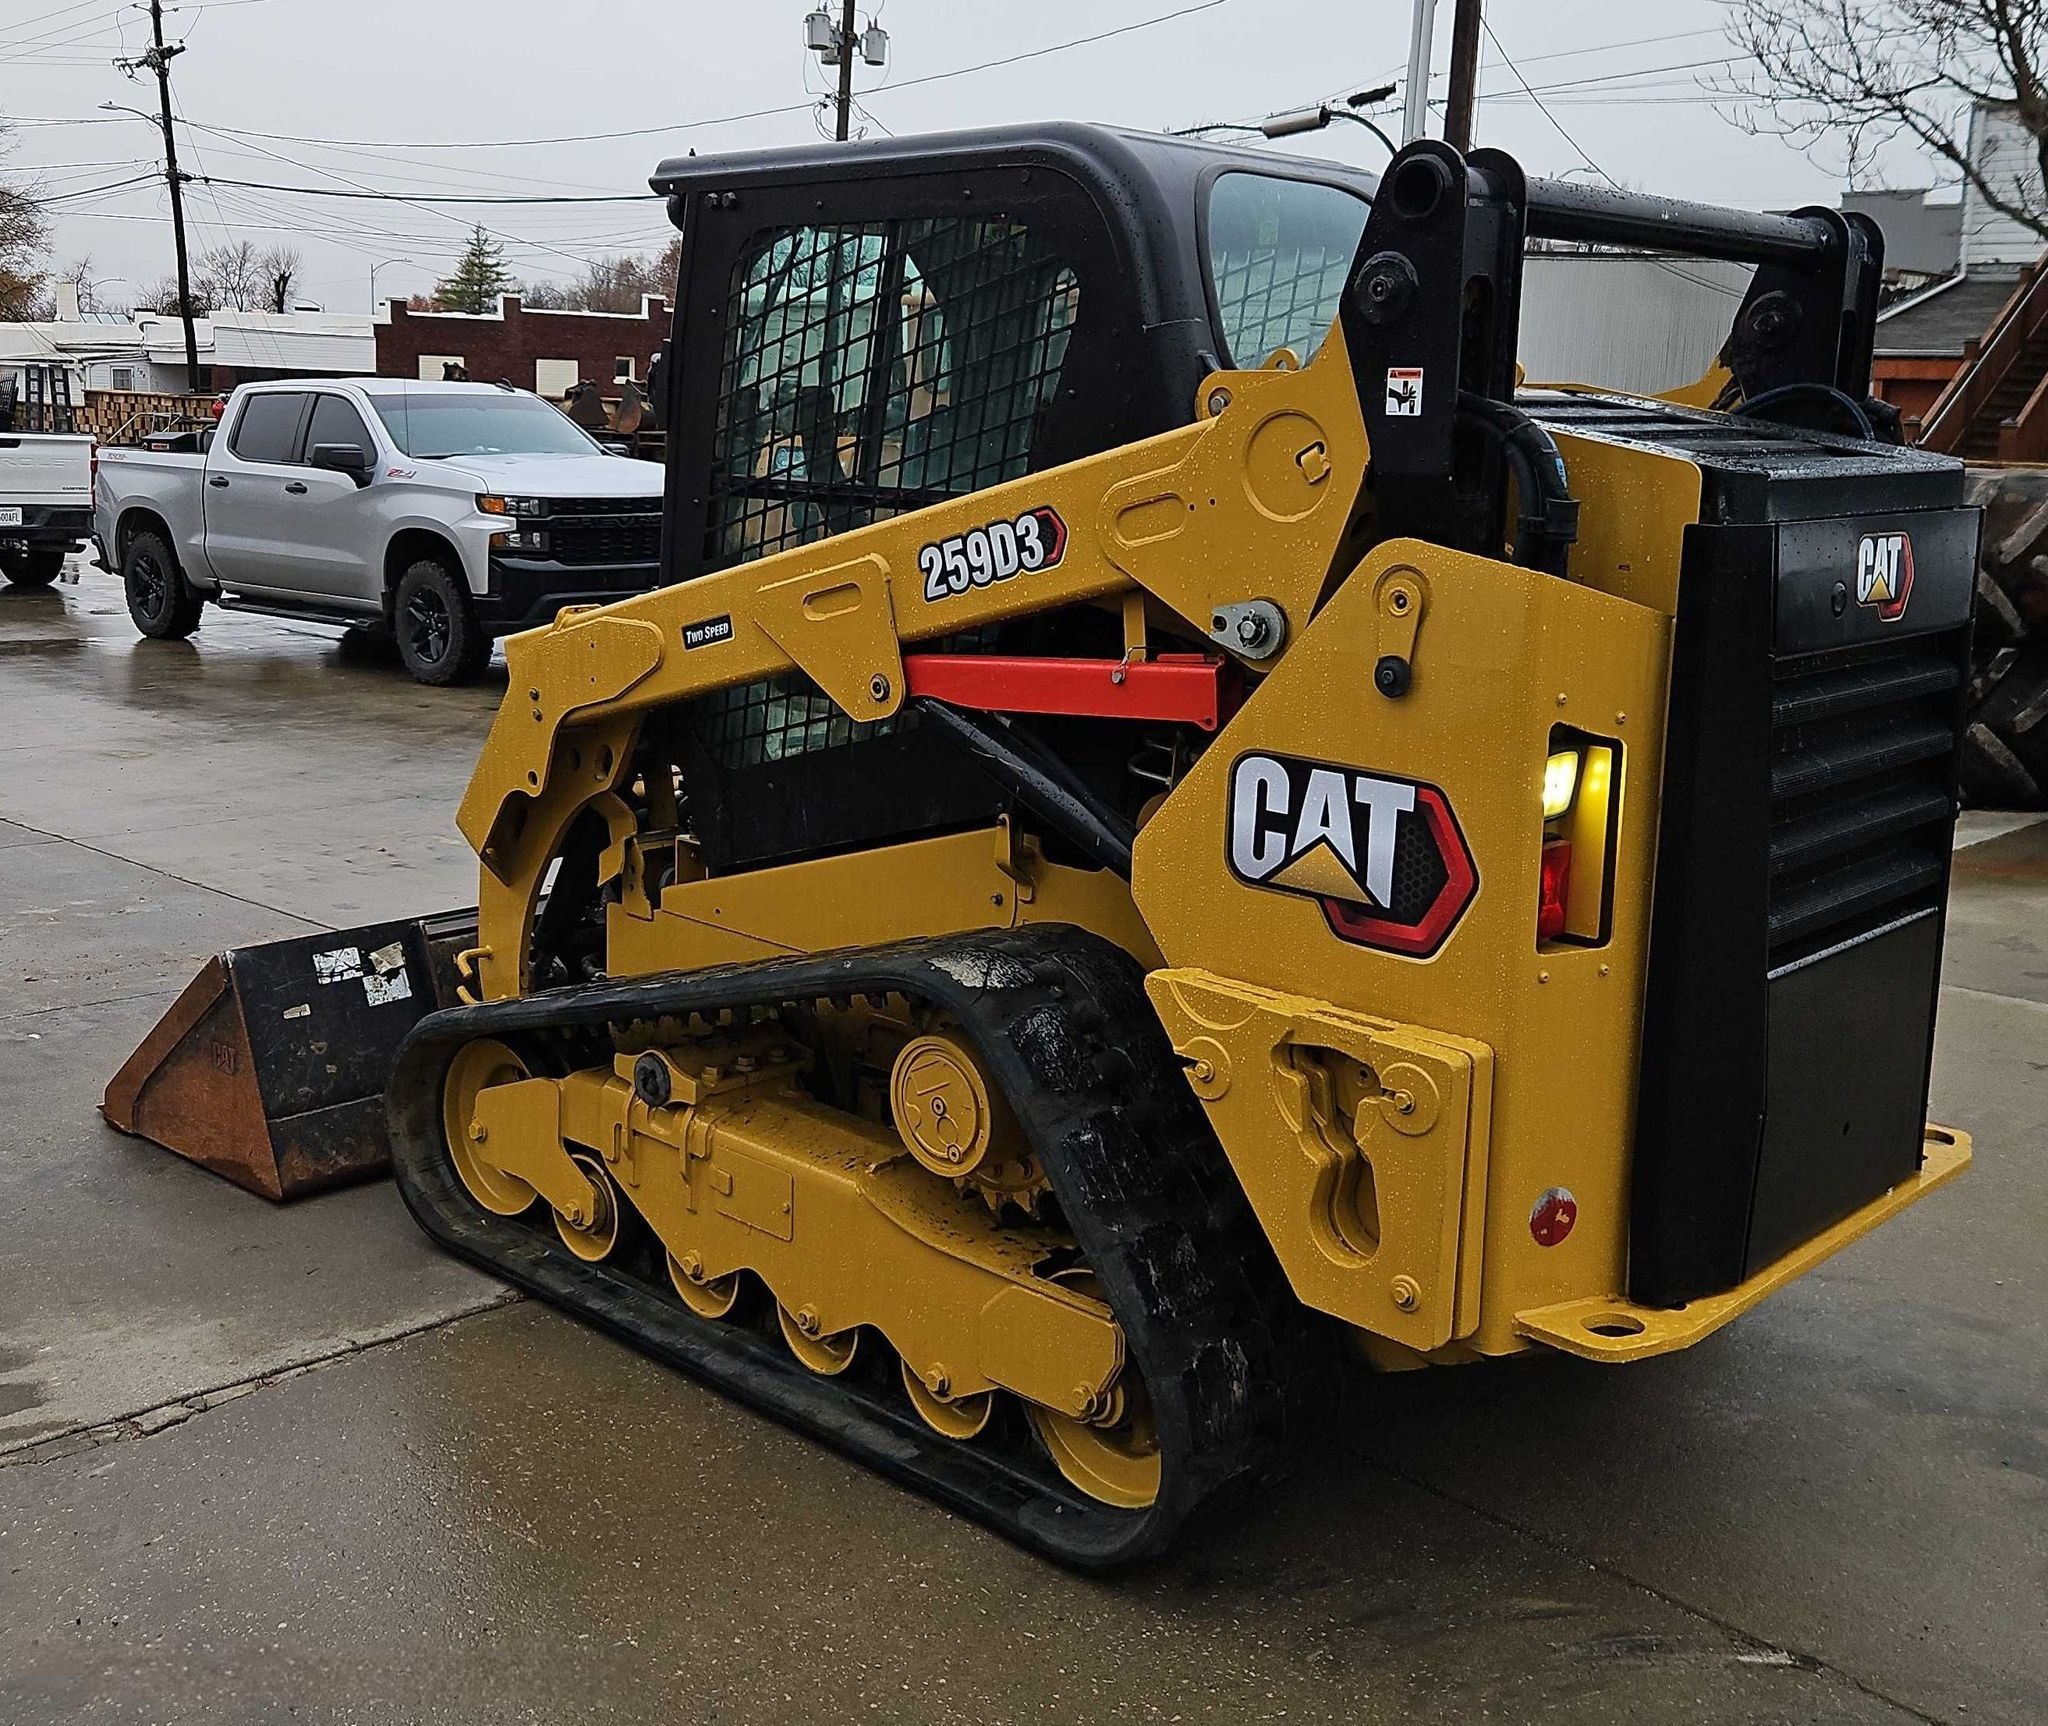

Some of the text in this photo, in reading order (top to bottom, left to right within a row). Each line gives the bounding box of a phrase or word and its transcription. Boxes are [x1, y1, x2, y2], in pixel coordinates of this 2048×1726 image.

[920, 515, 1044, 599] 259D3
[1857, 536, 1902, 602] CAT
[1232, 756, 1416, 909] CAT
